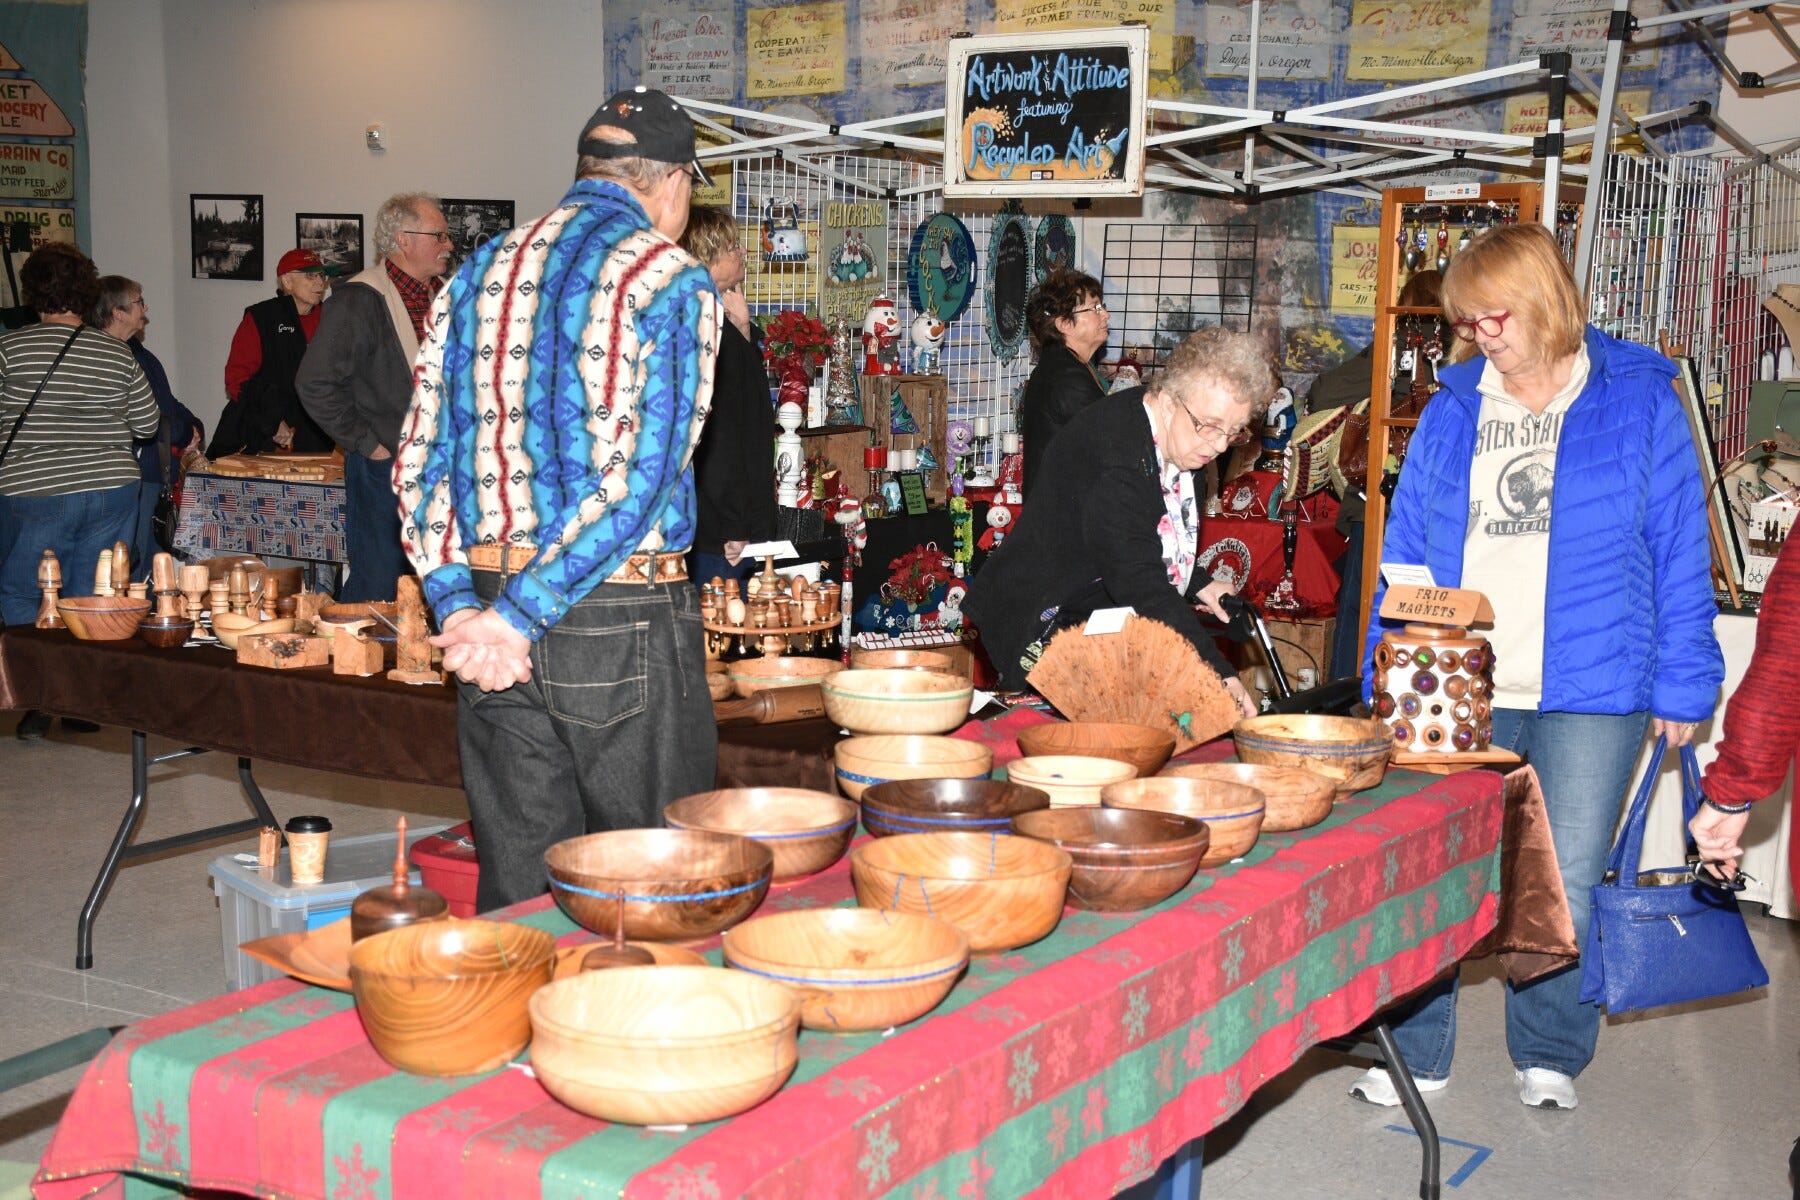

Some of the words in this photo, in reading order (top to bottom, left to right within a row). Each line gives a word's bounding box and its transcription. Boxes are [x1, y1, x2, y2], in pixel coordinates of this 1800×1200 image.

[1138, 3, 1165, 13] OUR
[1574, 15, 1612, 27] AMIT
[754, 33, 832, 49] COOPERATIVE
[1268, 55, 1312, 76] Oregon
[676, 74, 712, 83] DELIVER
[967, 55, 1043, 100] Artwork
[1052, 52, 1131, 98] Attitude
[1013, 97, 1074, 129] featuring
[968, 121, 1055, 180] Recycled
[1064, 125, 1103, 172] Art
[2, 165, 26, 176] MAID
[24, 178, 46, 188] FEED
[1415, 588, 1449, 601] FRIG
[1396, 601, 1456, 618] MAGNETS
